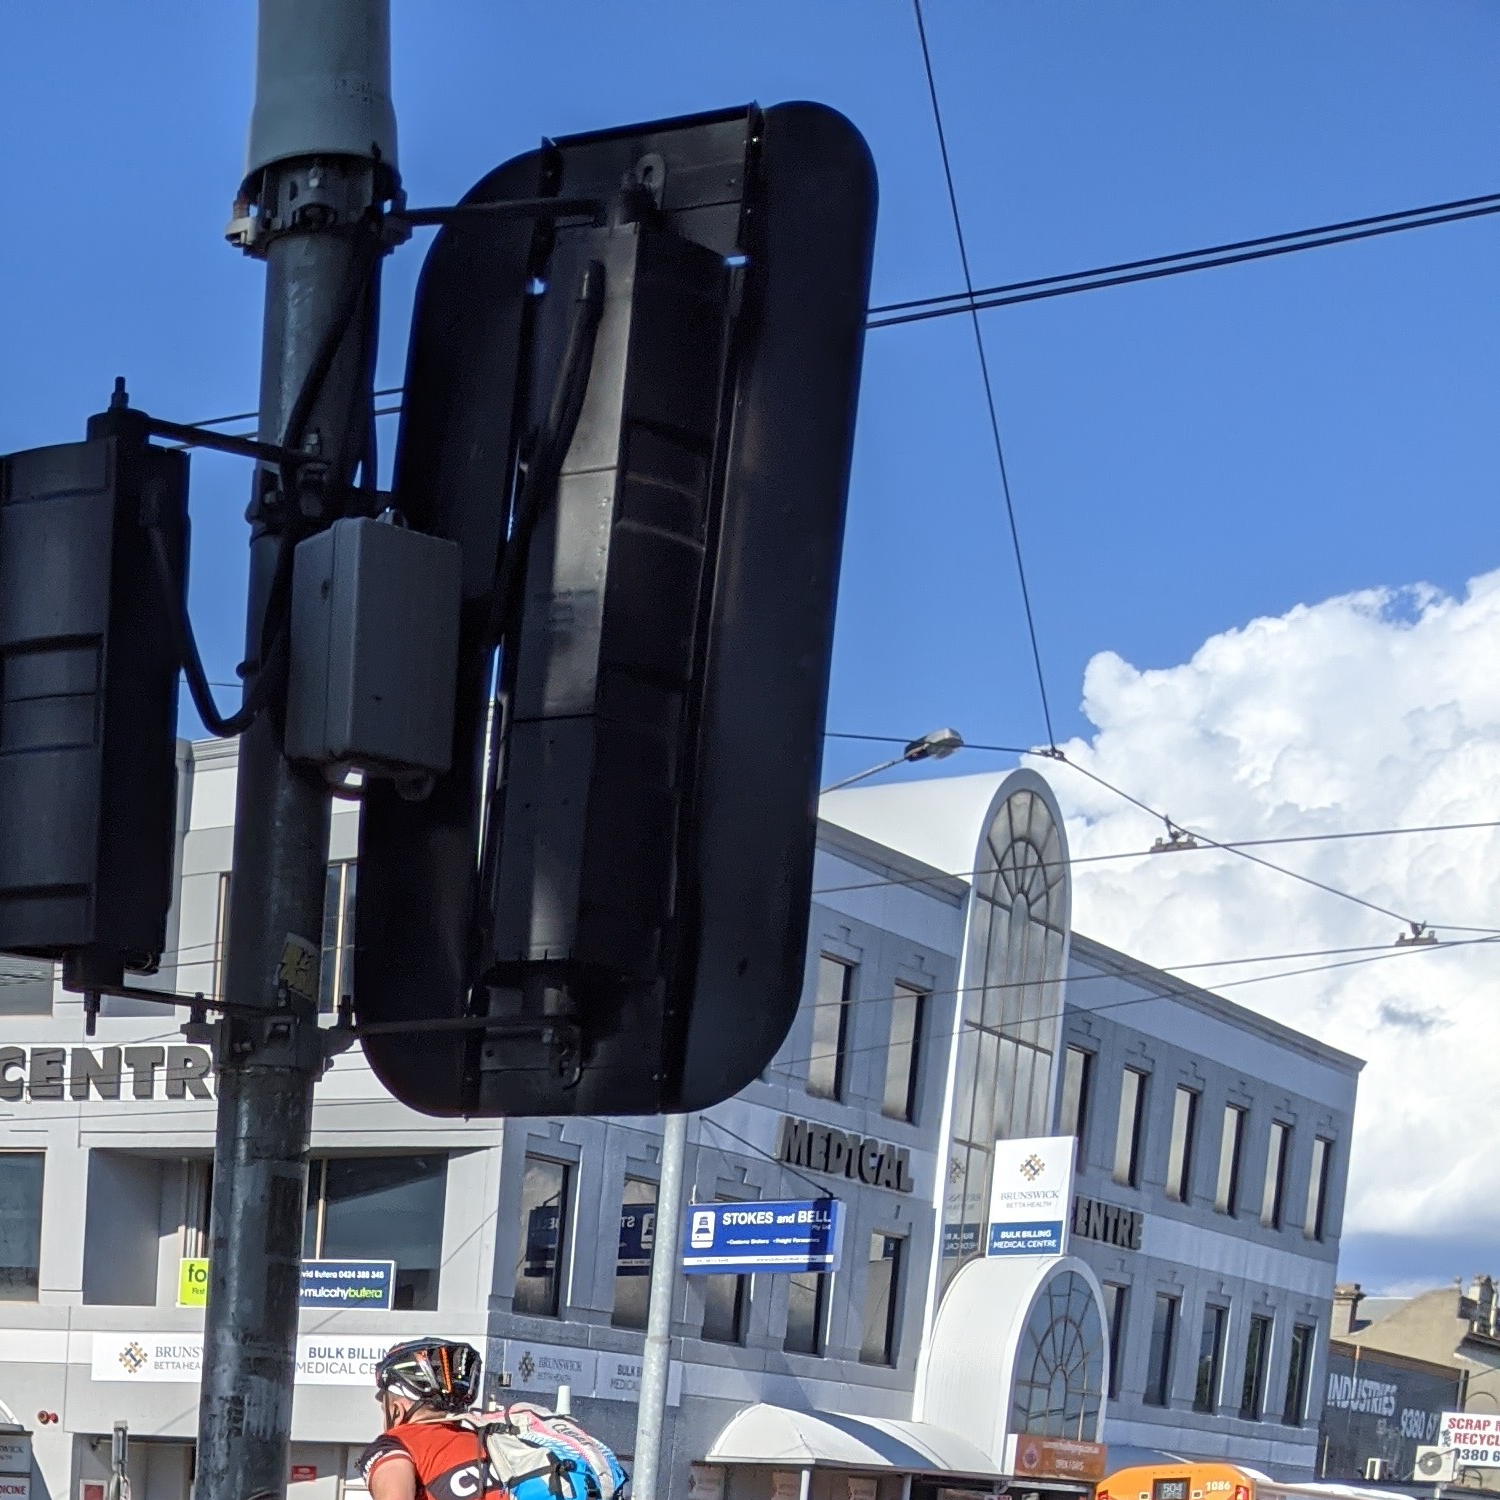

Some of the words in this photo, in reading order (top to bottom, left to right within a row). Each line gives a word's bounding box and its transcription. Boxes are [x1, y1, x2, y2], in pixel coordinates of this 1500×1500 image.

[777, 1115, 915, 1192] MEDICAL
[1000, 1190, 1060, 1200] BRUNSWICK
[722, 1212, 773, 1225] STOKES
[776, 1213, 795, 1224] and
[798, 1210, 831, 1223] BELL
[1074, 1194, 1144, 1250] ENTRE
[1001, 1231, 1020, 1239] BULK
[1022, 1229, 1052, 1238] BILLING
[993, 1241, 1026, 1249] MEDICAL
[1027, 1239, 1057, 1248] CENTRE
[301, 1270, 313, 1278] vid
[308, 1347, 344, 1359] BULK
[154, 1362, 180, 1370] BETTA
[296, 1362, 356, 1374] MEDICAL
[538, 1357, 582, 1372] BRUNSWICK
[617, 1364, 635, 1377] BULK
[1327, 1373, 1398, 1417] INDUSTRIES
[1401, 1408, 1426, 1440] 9380
[1448, 1417, 1491, 1431] SCRAP
[1205, 1480, 1231, 1491] 1086
